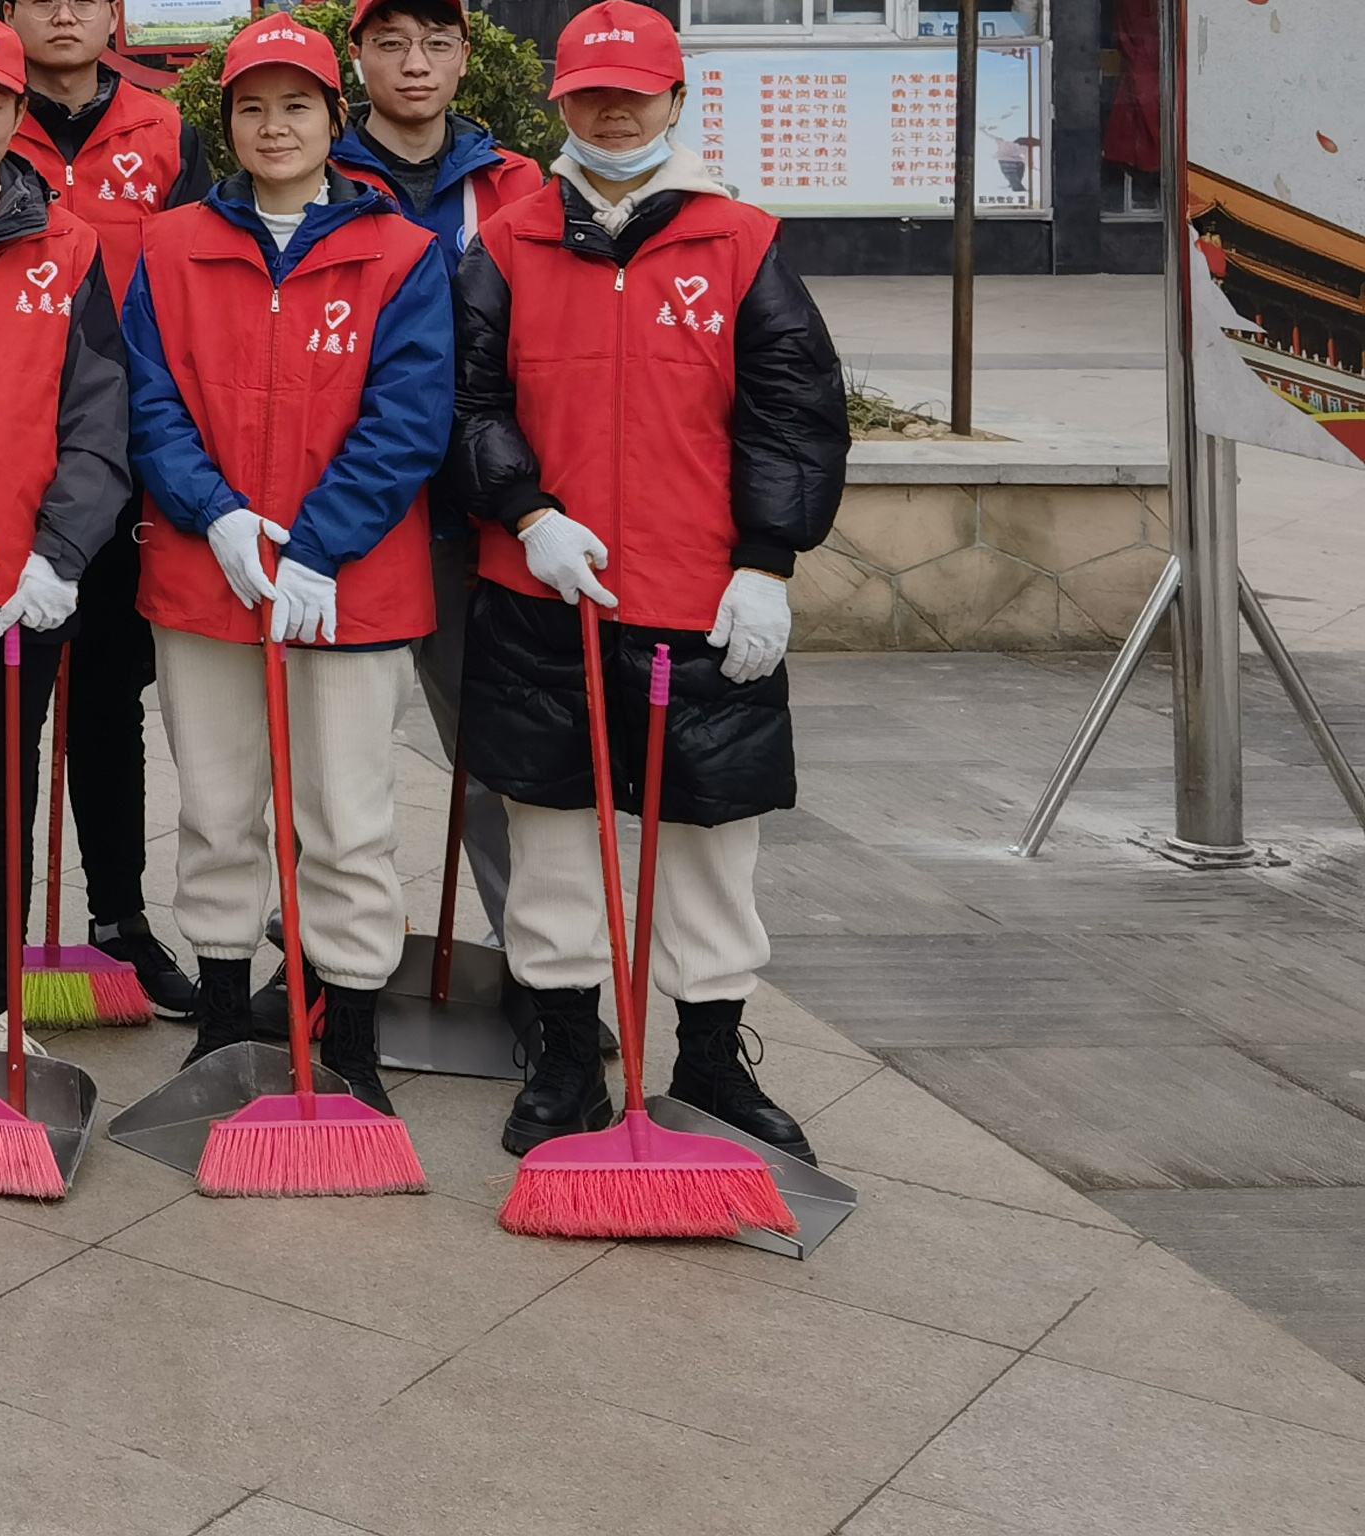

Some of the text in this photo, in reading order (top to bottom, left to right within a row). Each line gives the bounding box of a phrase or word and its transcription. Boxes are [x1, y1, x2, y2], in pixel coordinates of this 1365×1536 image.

[256, 28, 306, 45] 建发检测
[583, 28, 635, 45] 建发检测
[760, 74, 847, 85] 要热爱祖国
[760, 89, 847, 100] 要爱岗敬业
[760, 103, 847, 114] 要诚实守信
[760, 118, 847, 129] 要尊老爱幼
[702, 71, 724, 188] 淮南市民文明公
[760, 133, 847, 143] 要遵纪守法
[760, 147, 847, 158] 要见义勇为
[760, 162, 847, 172] 要讲究卫生
[760, 176, 847, 187] 要注重礼仪
[98, 178, 157, 204] 志愿者
[16, 290, 72, 317] 志愿者
[656, 301, 724, 335] 志愿者
